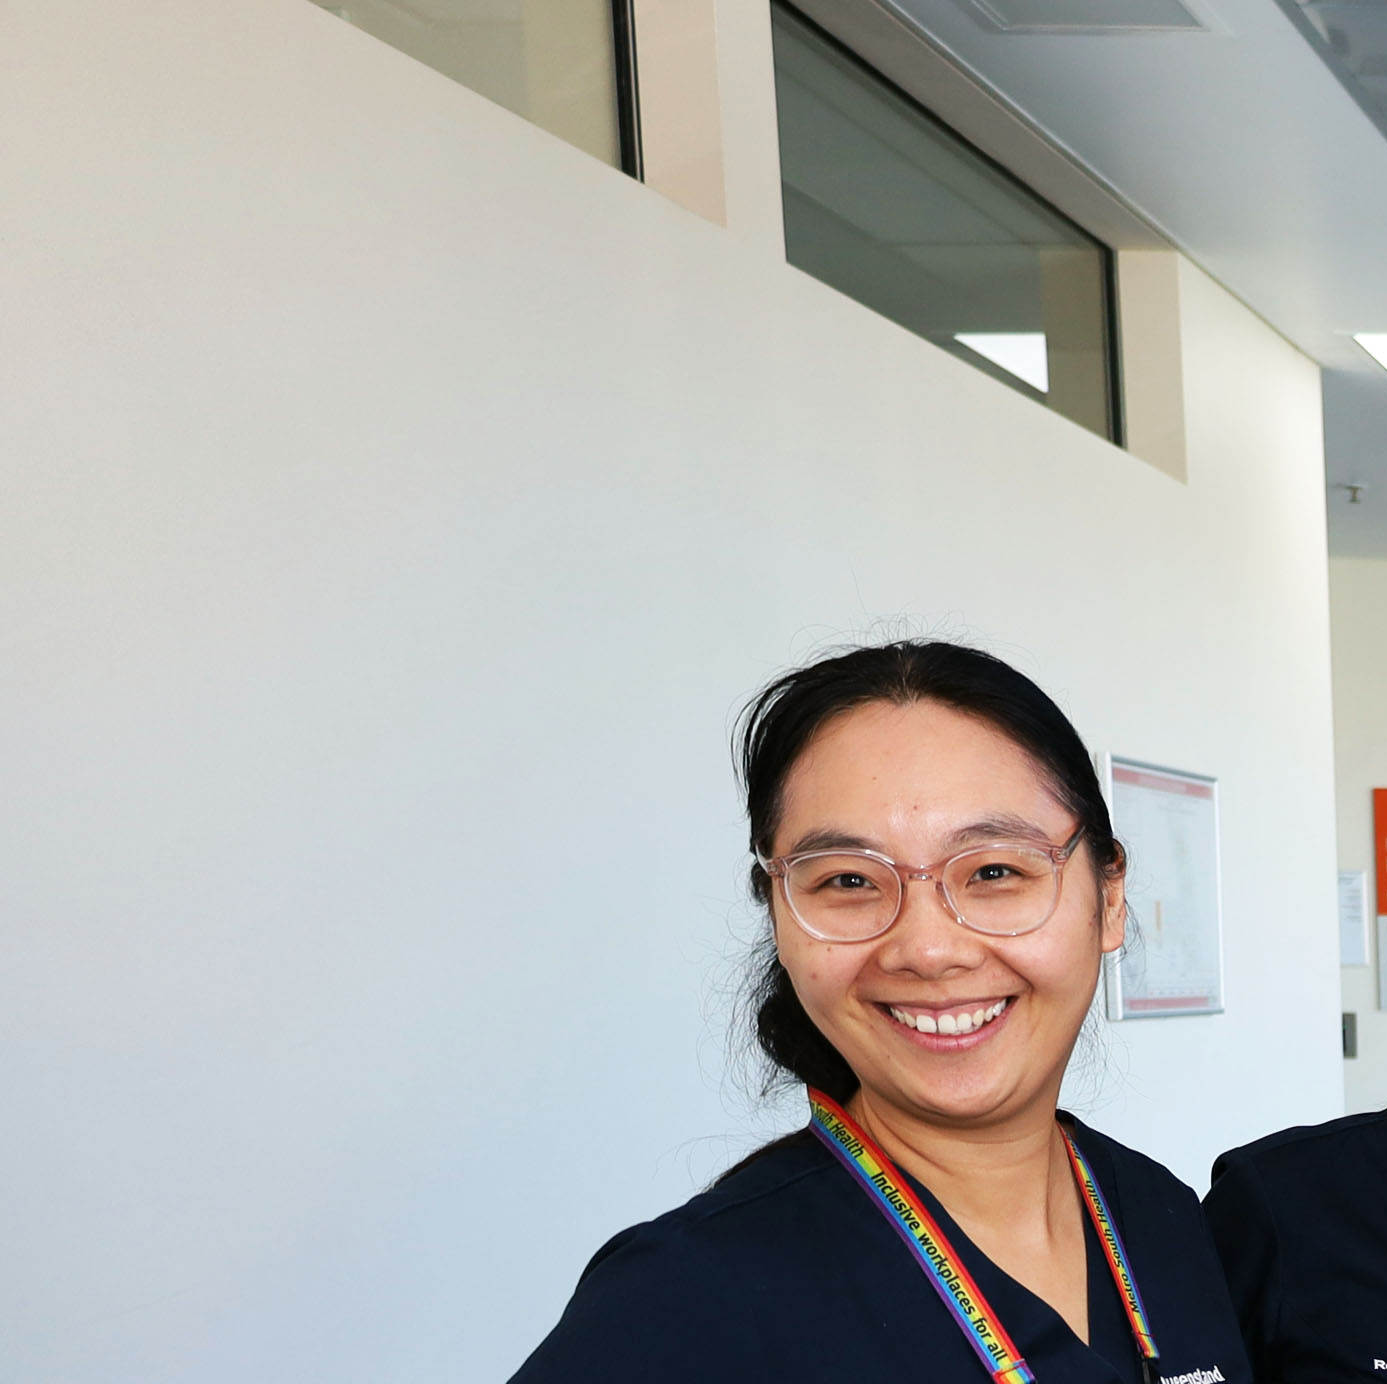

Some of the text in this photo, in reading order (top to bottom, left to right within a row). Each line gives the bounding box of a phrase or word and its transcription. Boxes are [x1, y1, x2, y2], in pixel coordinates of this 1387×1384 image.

[831, 1121, 865, 1159] Health
[870, 1171, 921, 1232] Inclusive
[918, 1232, 976, 1316] workplaces
[972, 1317, 993, 1340] for
[987, 1342, 1009, 1363] all
[1085, 1180, 1141, 1314] Metro South Health
